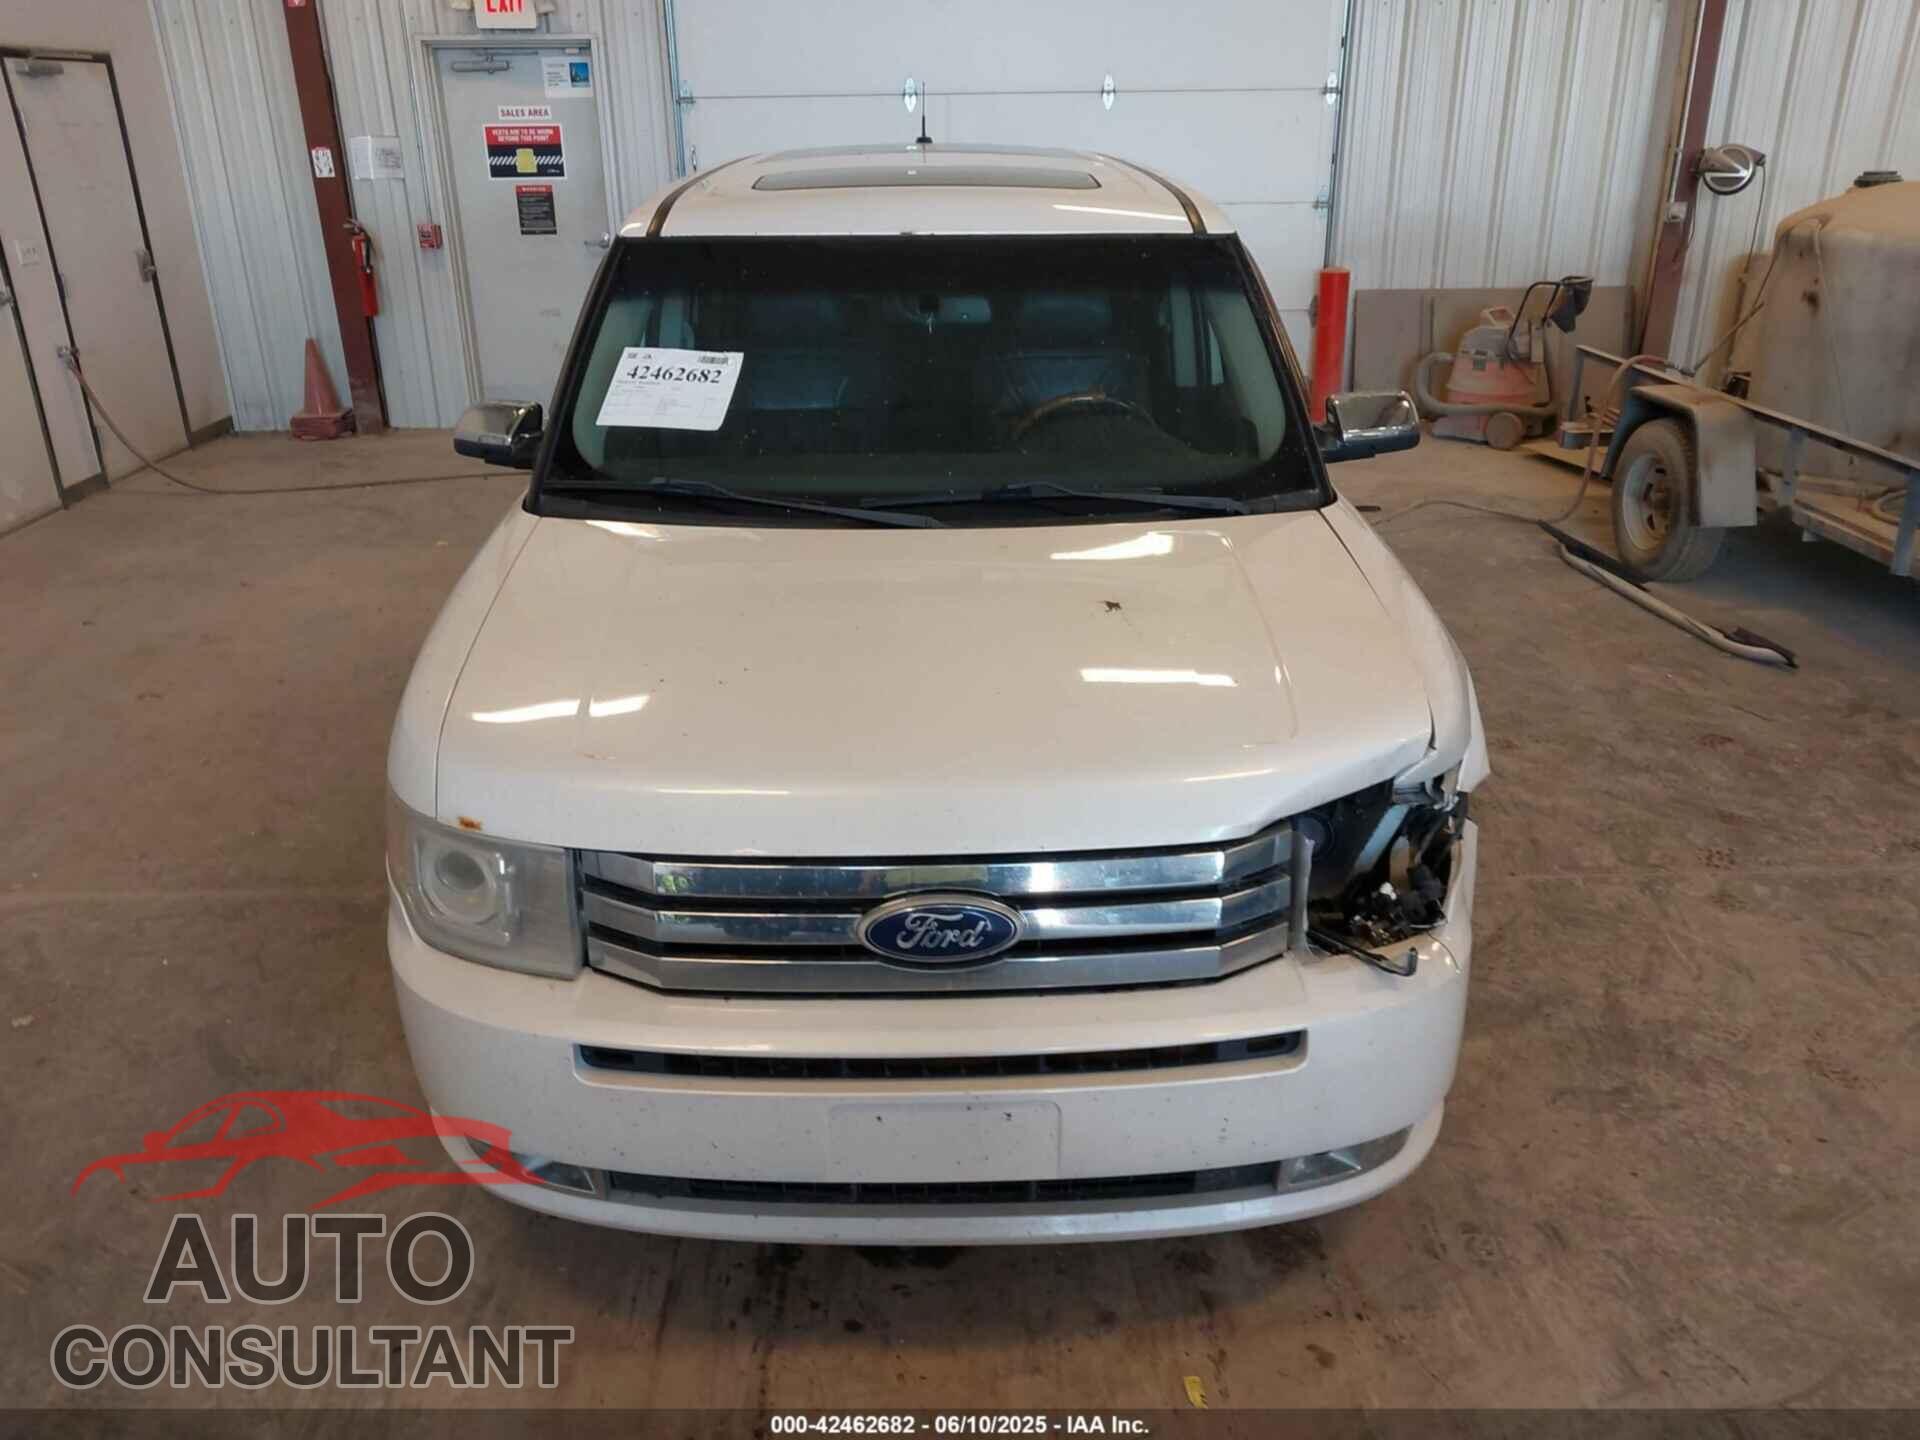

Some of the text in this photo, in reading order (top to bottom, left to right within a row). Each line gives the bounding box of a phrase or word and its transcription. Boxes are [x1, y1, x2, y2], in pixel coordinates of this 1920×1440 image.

[500, 107, 549, 117] SALES AREA
[627, 365, 722, 384] 42462682
[896, 911, 992, 949] Ford
